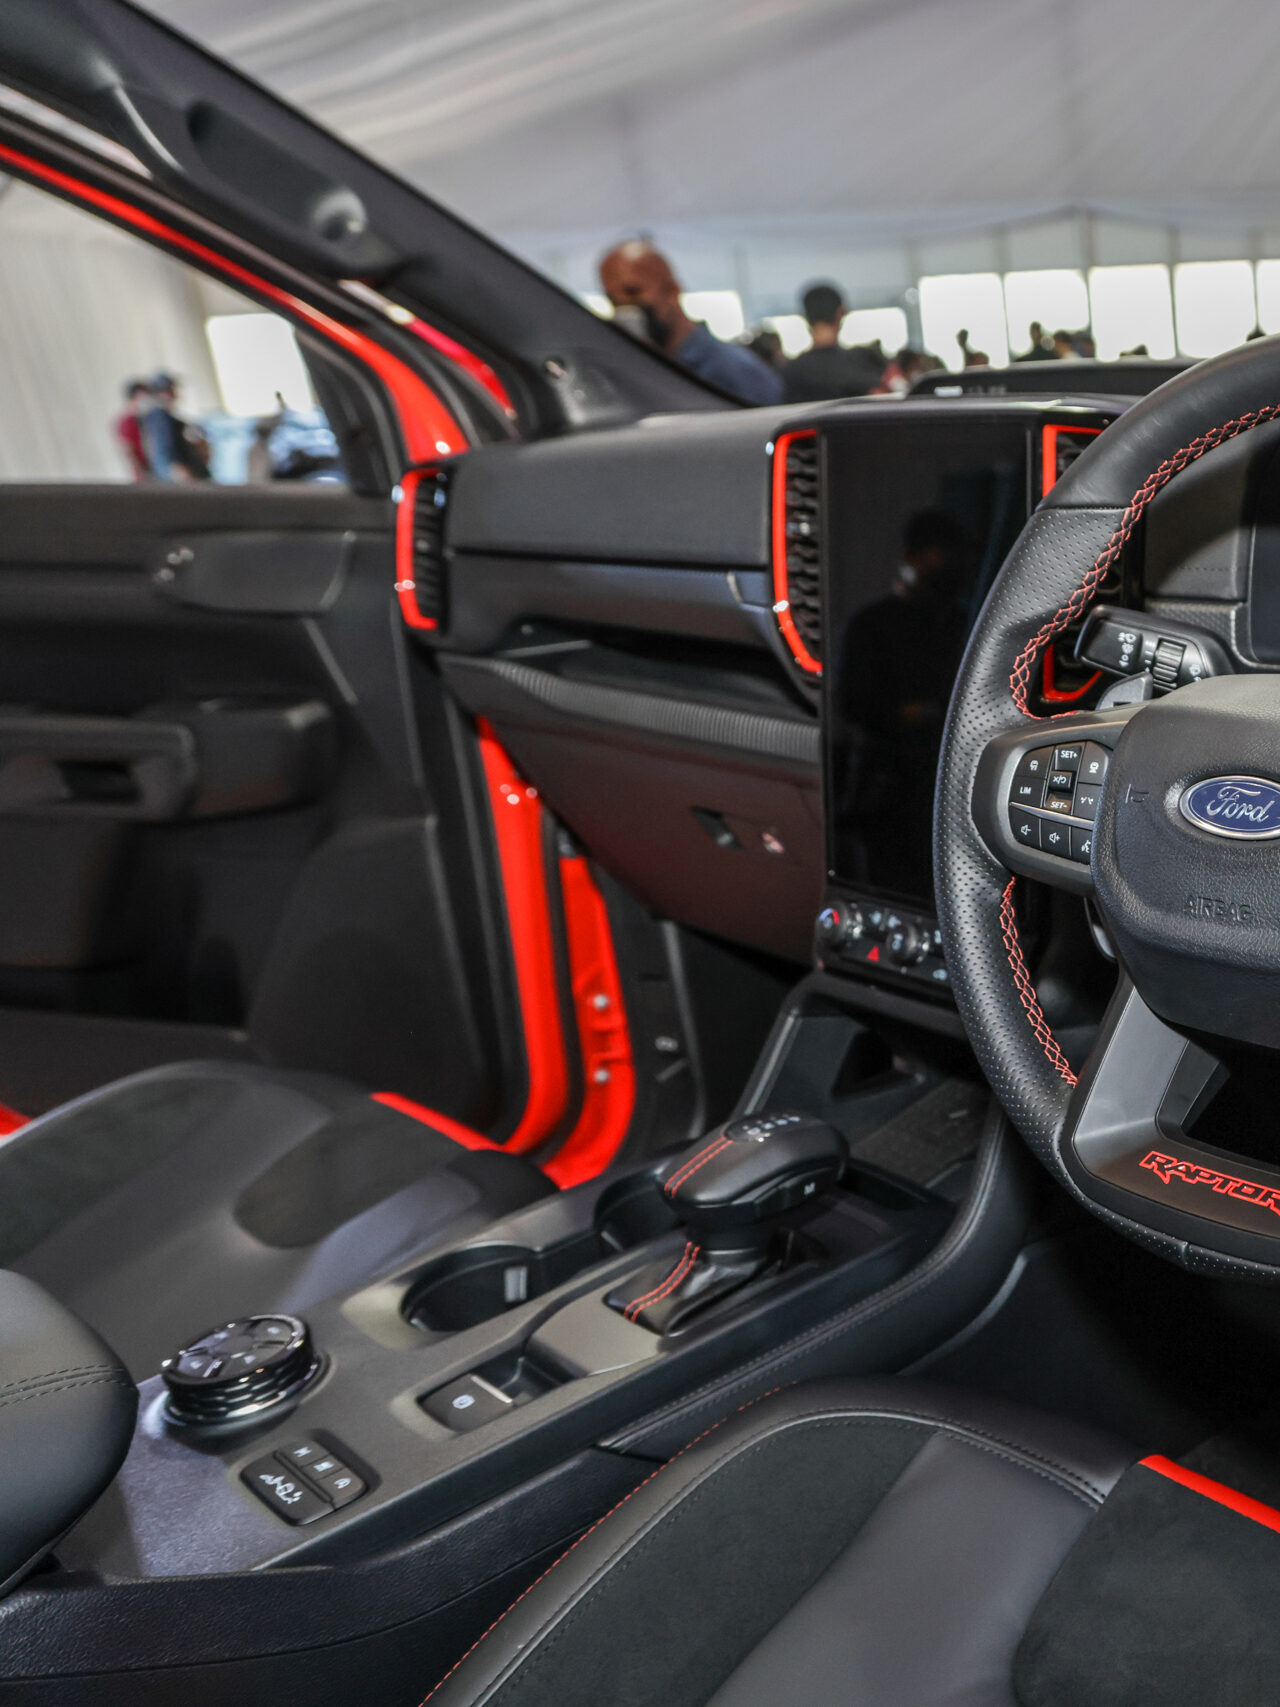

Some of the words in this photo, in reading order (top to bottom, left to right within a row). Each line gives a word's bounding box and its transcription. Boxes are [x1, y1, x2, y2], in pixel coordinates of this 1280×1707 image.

[1019, 786, 1032, 795] LIM
[1206, 786, 1275, 823] Ford
[1183, 895, 1255, 923] AIRBAG
